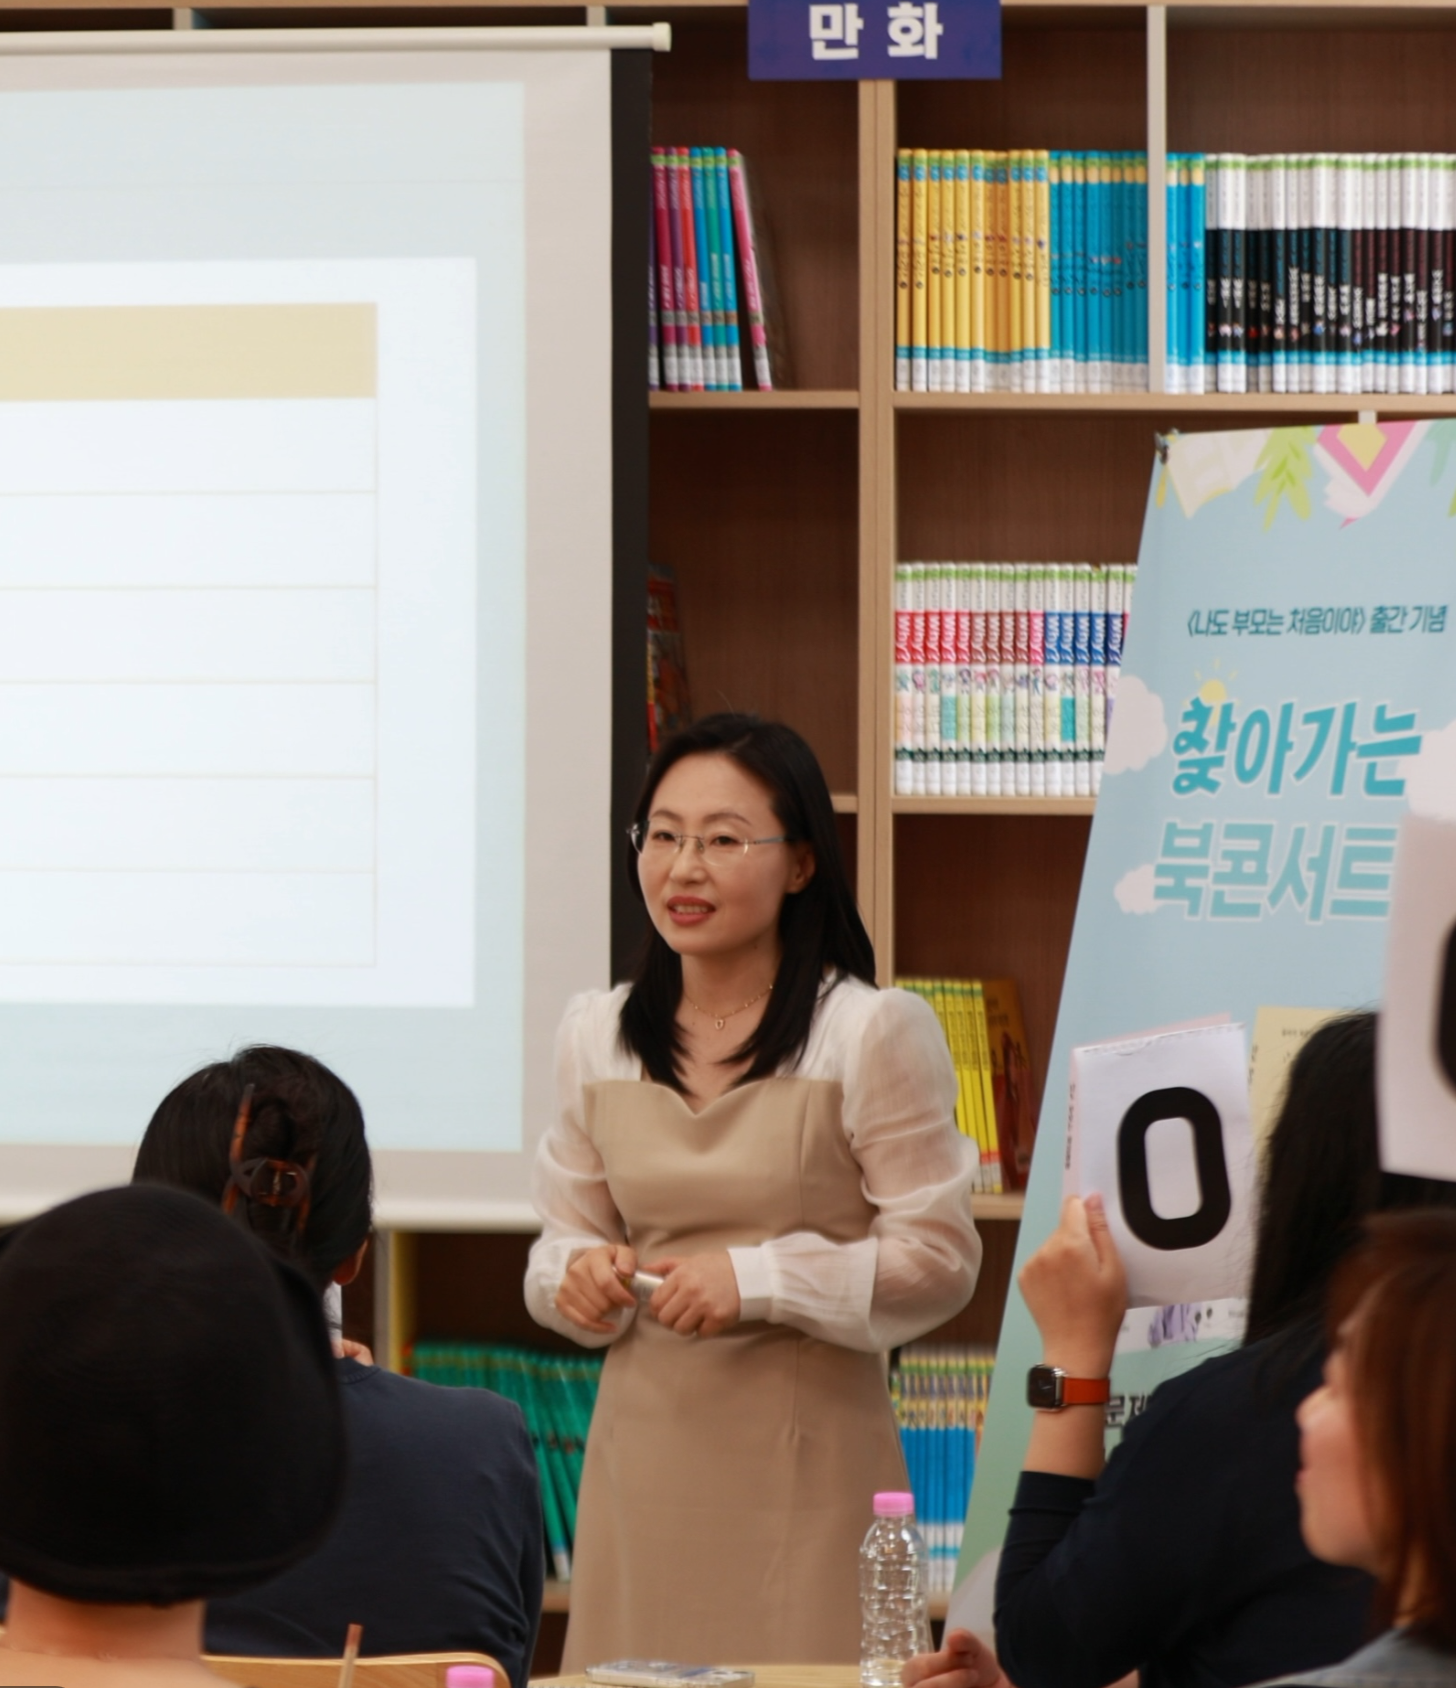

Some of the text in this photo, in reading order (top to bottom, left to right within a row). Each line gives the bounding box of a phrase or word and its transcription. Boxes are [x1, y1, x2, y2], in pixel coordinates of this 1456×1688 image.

[1232, 608, 1284, 636] 부모는
[1370, 604, 1408, 634] 출간
[1409, 604, 1448, 634] 기념
[1171, 696, 1422, 797] 찾아가는
[1152, 820, 1399, 922] 북콘서트
